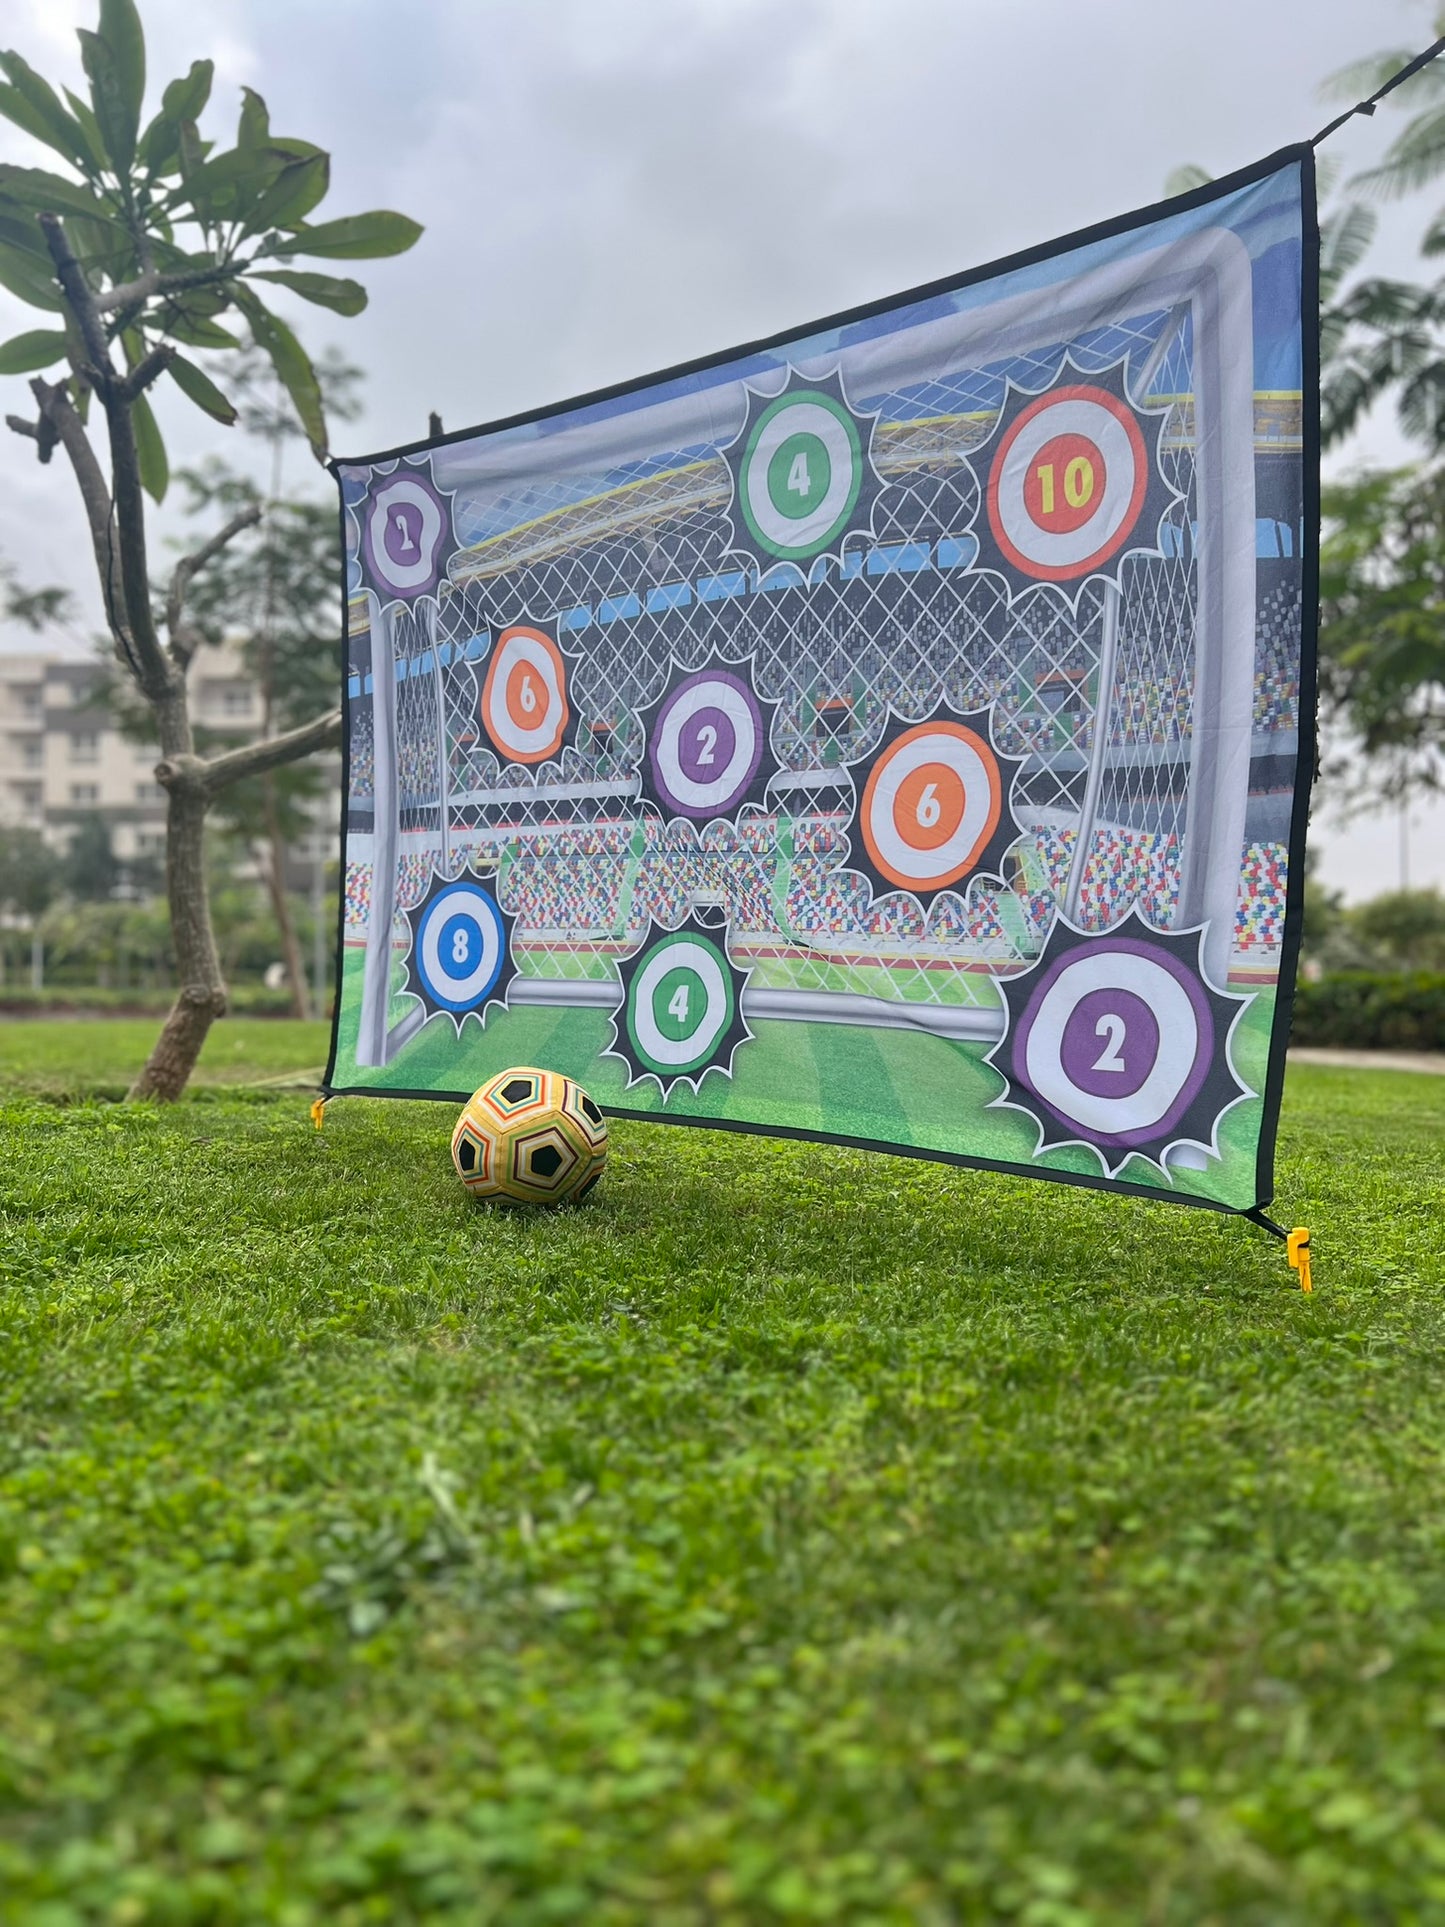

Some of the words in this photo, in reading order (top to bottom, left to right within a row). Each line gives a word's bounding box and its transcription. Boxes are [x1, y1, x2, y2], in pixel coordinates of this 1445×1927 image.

[787, 452, 811, 496] 4
[1036, 456, 1094, 514] 10
[395, 515, 415, 551] 2
[520, 675, 537, 713] 6
[696, 725, 718, 765] 2
[916, 783, 941, 828] 6
[452, 928, 468, 963] 8
[668, 985, 689, 1023] 4
[1090, 1013, 1126, 1072] 2
